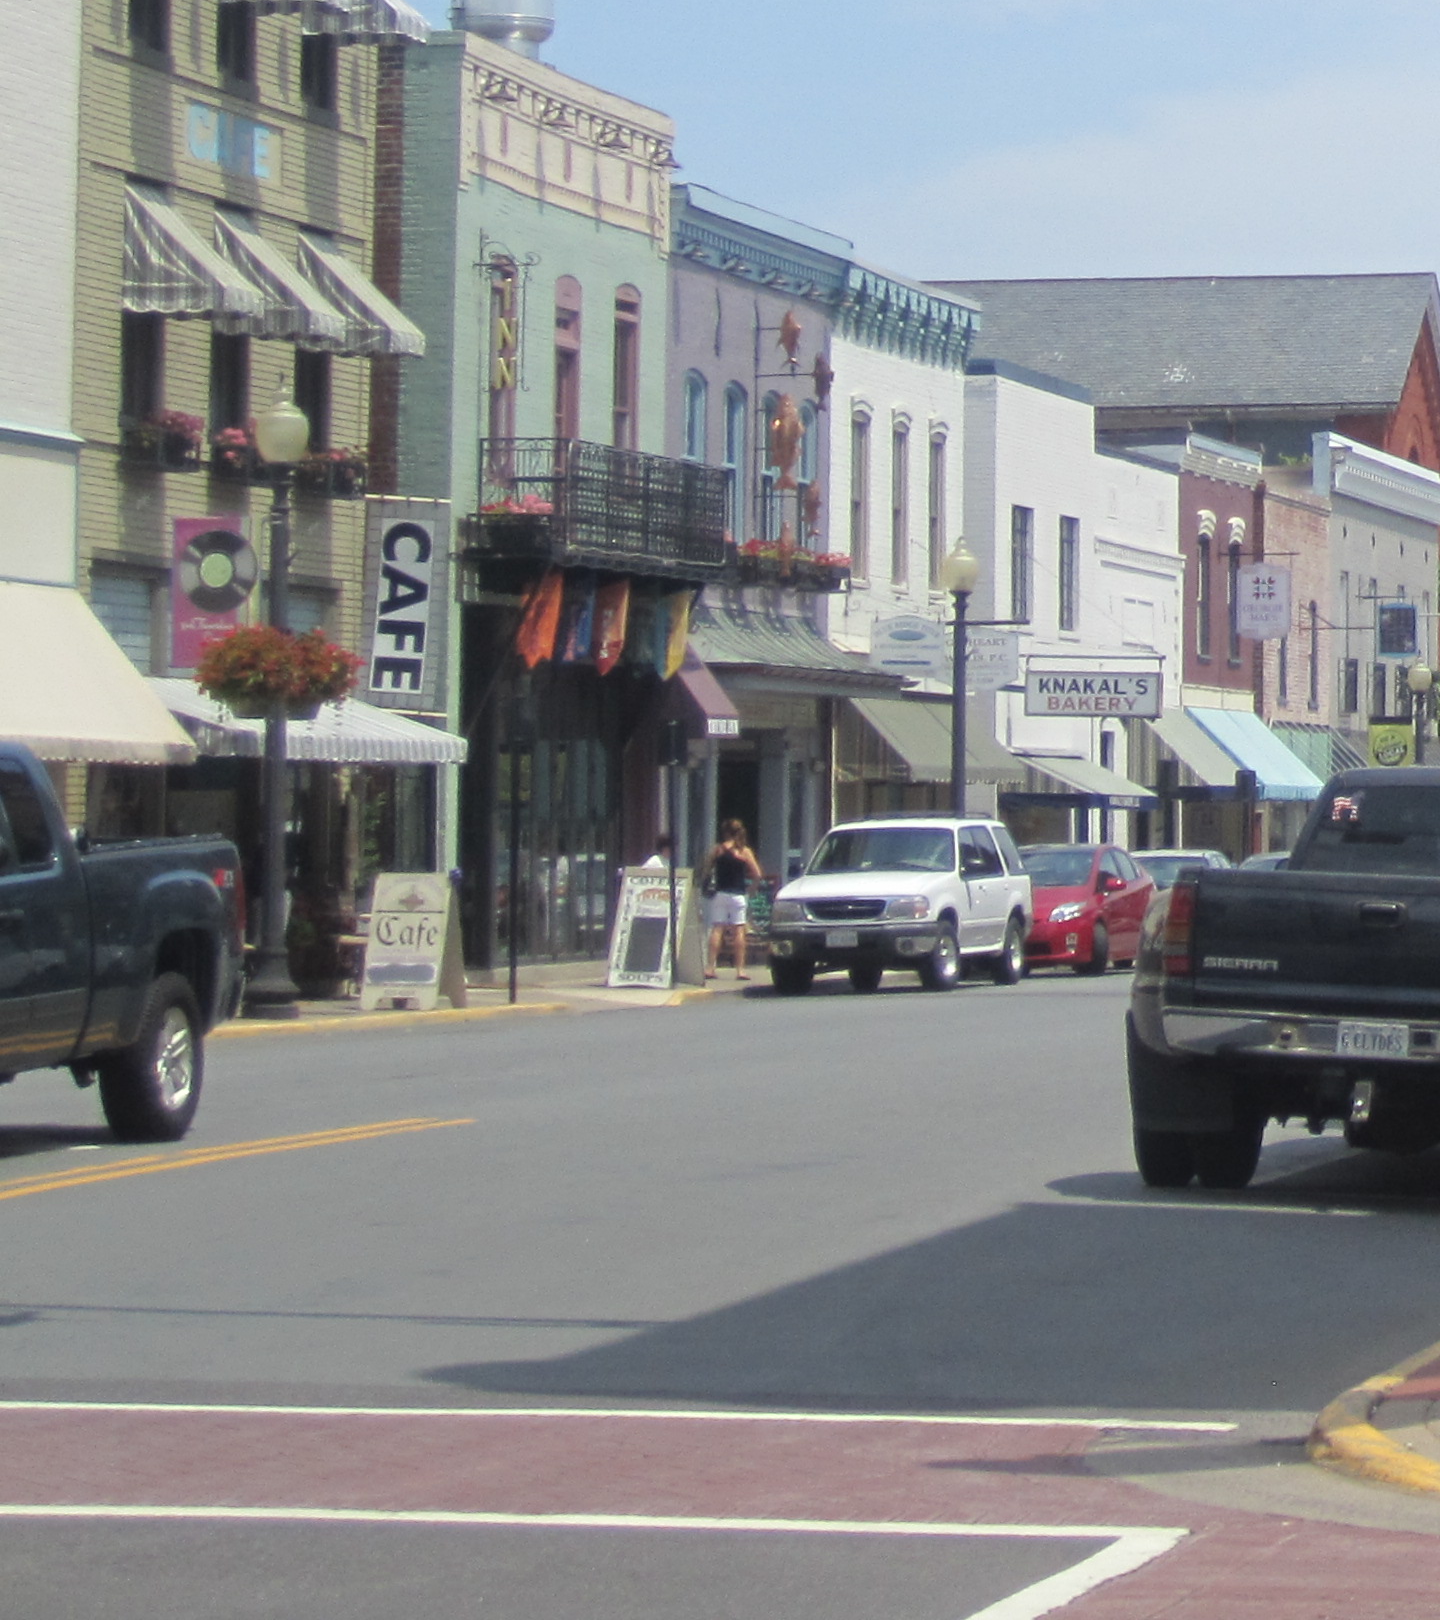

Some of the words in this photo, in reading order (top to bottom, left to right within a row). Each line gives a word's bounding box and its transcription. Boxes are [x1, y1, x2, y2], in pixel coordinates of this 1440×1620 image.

[372, 522, 432, 690] CAFE
[1038, 677, 1148, 695] KNAKAL'S
[1047, 696, 1138, 711] BAKERY
